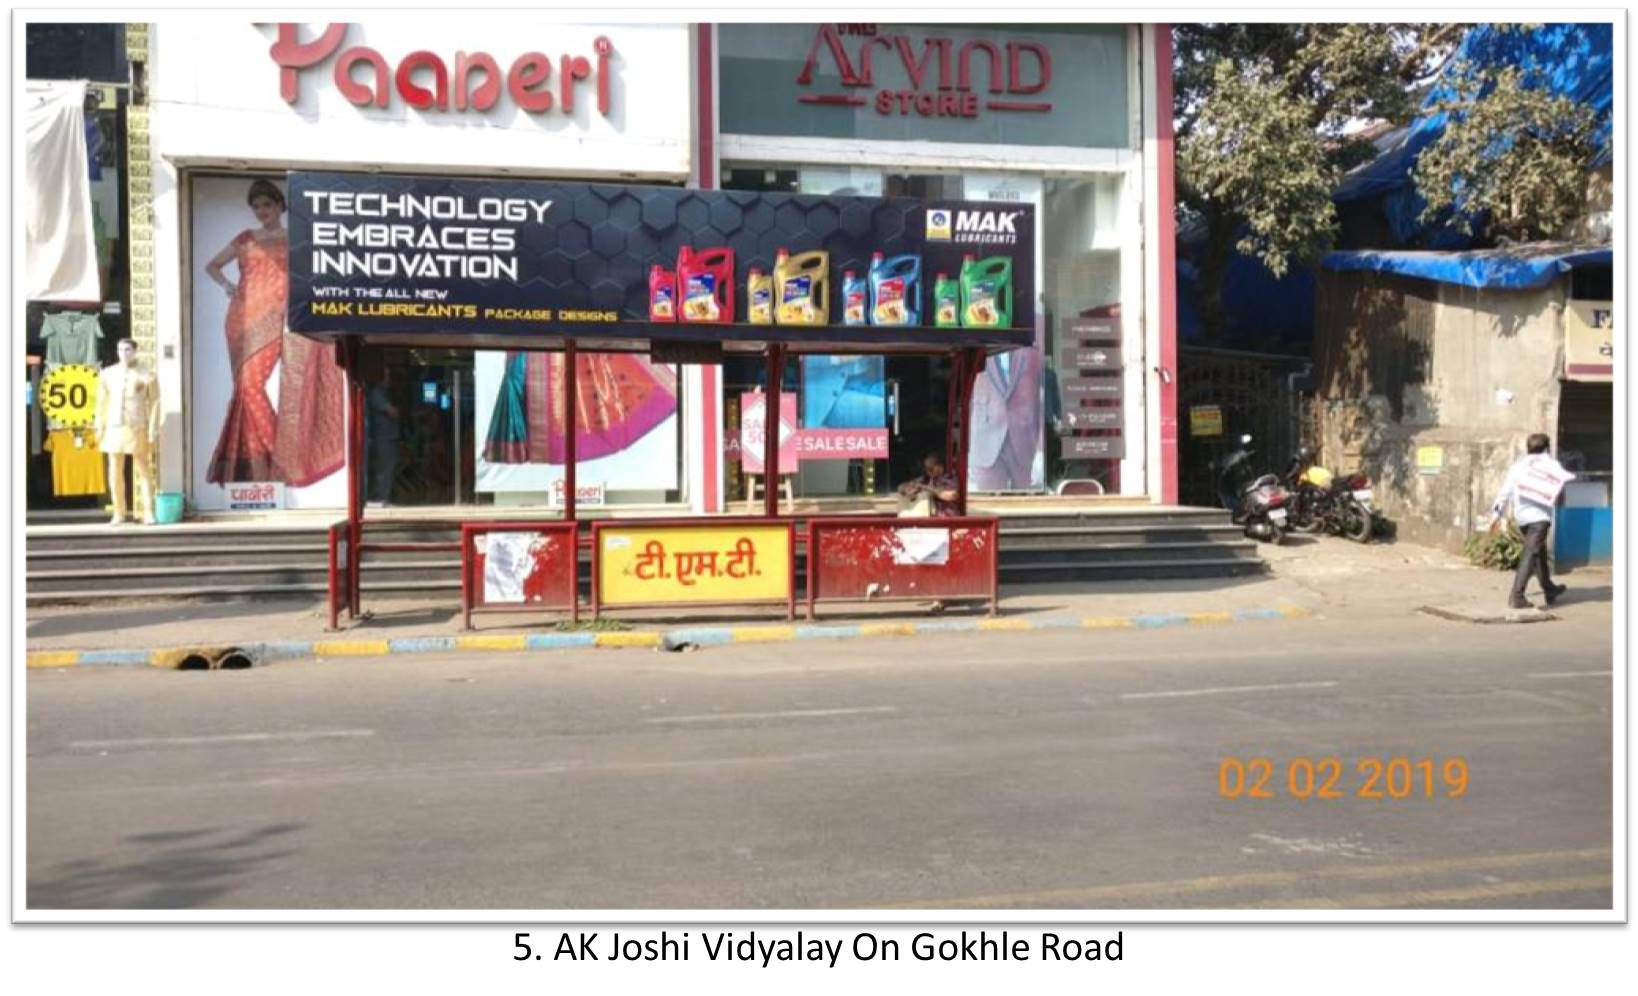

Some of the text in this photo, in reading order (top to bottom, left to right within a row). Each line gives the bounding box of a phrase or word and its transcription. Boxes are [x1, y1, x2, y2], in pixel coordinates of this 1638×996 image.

[875, 89, 979, 118] STORE
[304, 190, 553, 224] TECHNOLOGY
[955, 210, 1017, 233] MAK
[312, 222, 516, 251] EMBRACES
[954, 231, 1017, 244] LUBRICANTS
[312, 248, 518, 282] INNOVATION
[313, 286, 448, 300] WITH THE ALL NEW
[312, 302, 618, 322] MAK LUBRICANTS PACKAGE DESIGNS
[47, 383, 88, 409] 50
[634, 537, 762, 585] टी.एम.टी.
